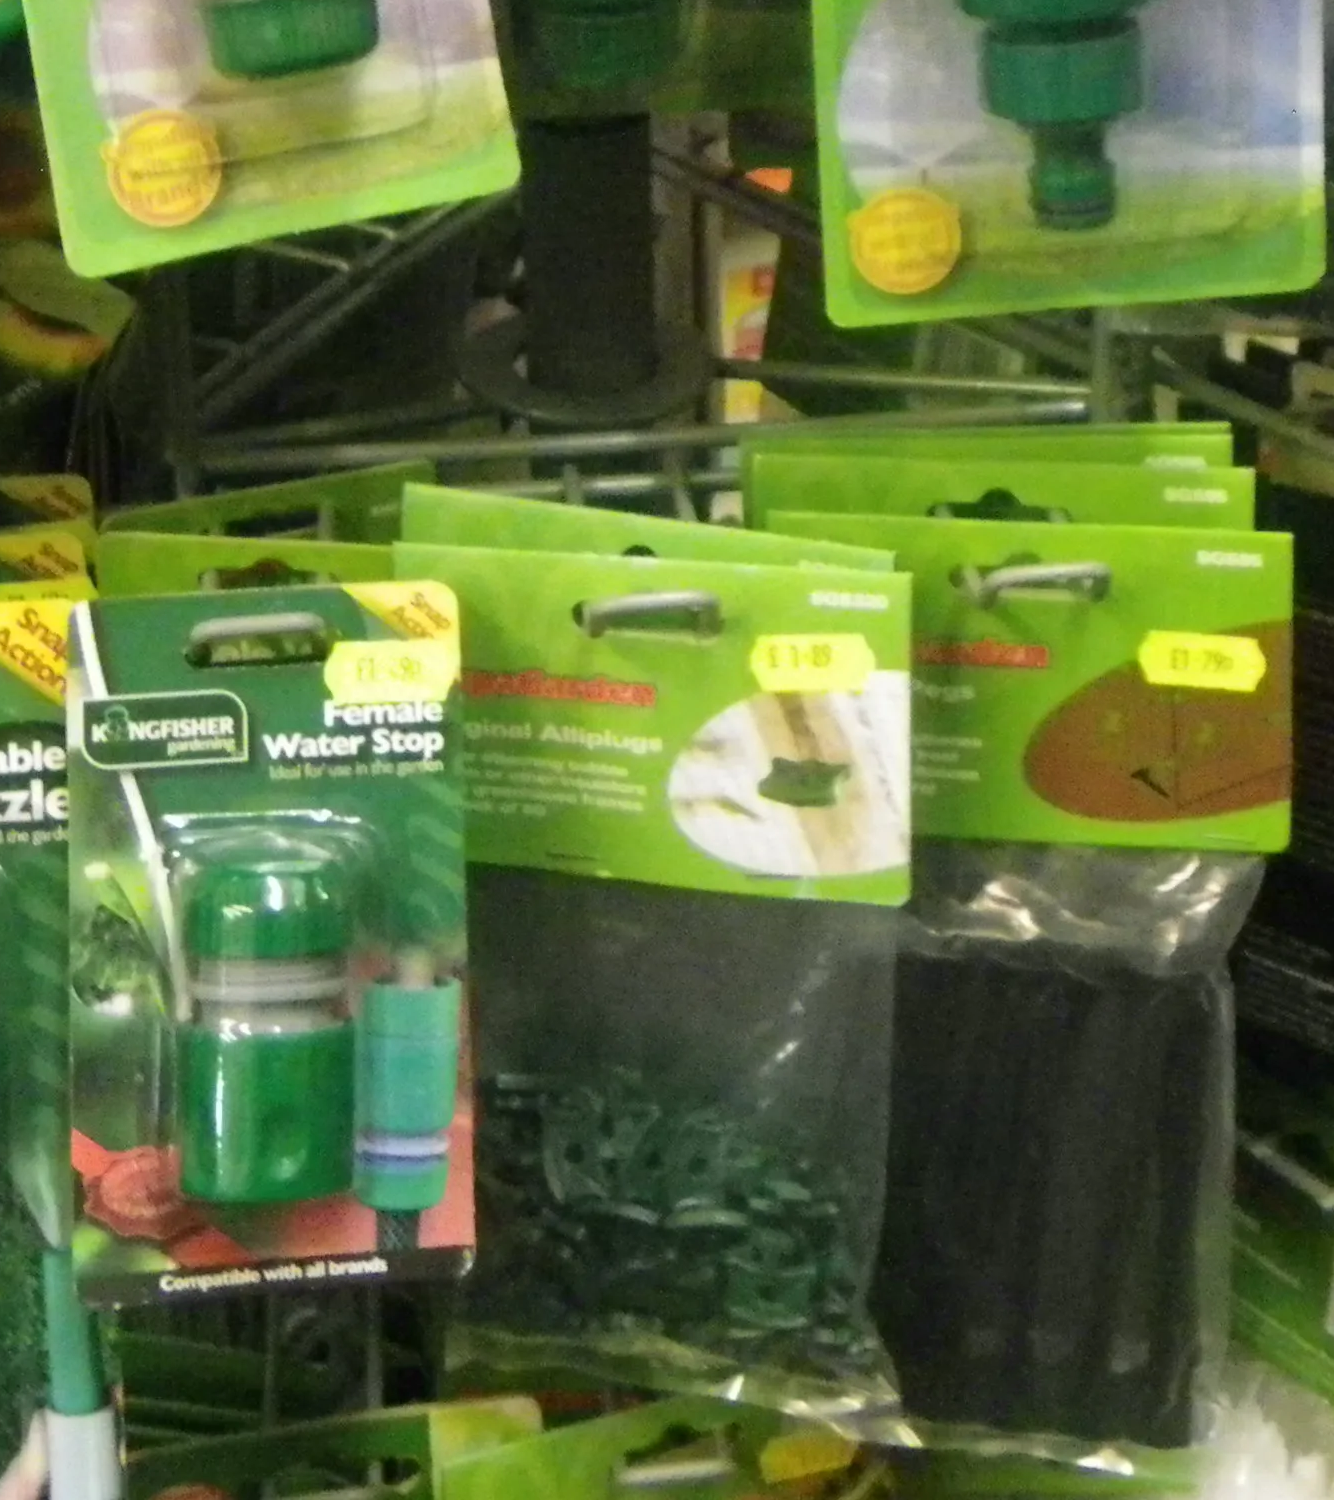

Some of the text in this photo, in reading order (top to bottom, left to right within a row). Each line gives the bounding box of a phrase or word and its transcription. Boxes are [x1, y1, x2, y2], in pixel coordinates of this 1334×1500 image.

[91, 705, 235, 743] KINGFISHER
[324, 700, 444, 728] Female
[262, 728, 445, 762] Water Stop
[466, 720, 531, 740] ginal
[32, 830, 69, 849] garde
[158, 1257, 388, 1294] Compatible with all brands
